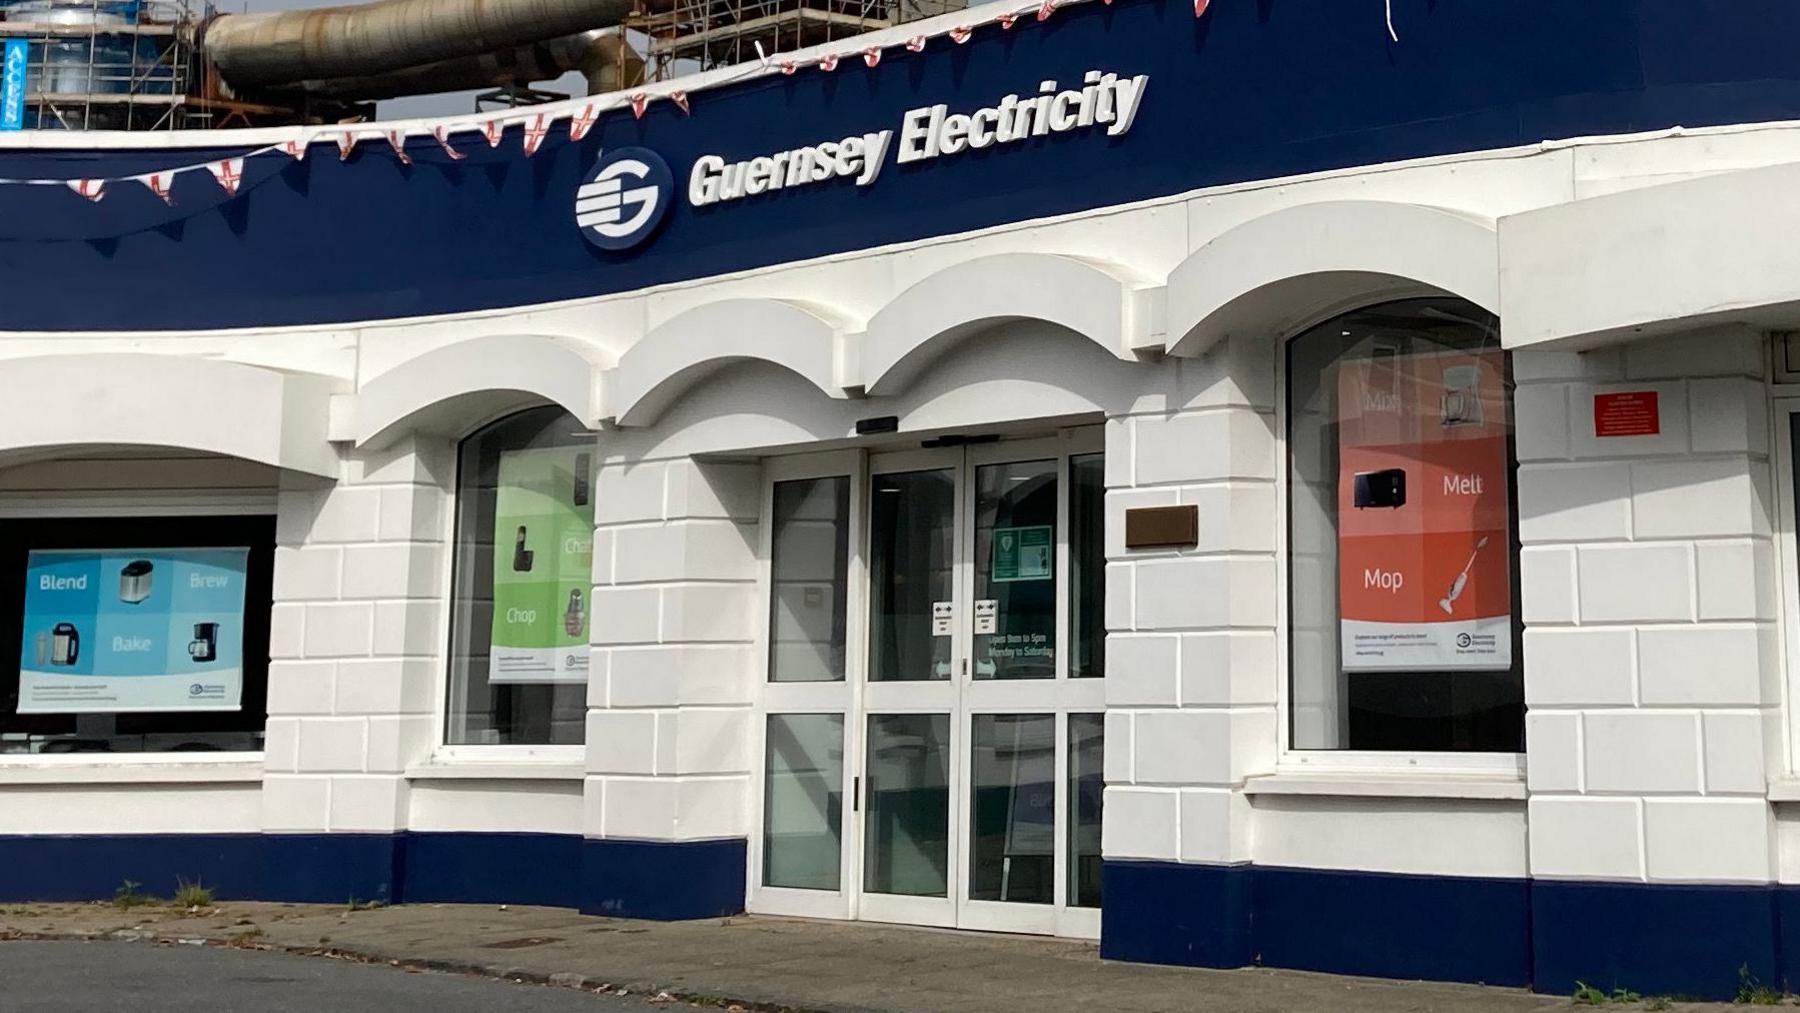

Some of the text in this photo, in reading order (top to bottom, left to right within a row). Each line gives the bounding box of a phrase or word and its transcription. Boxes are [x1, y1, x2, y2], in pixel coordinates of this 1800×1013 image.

[688, 70, 1149, 206] Guernsey Electricity
[1444, 475, 1483, 495] Melt
[40, 574, 87, 590] Blend
[190, 573, 228, 588] Brew
[1365, 569, 1403, 592] Mop
[507, 608, 536, 624] Chop
[113, 637, 151, 651] Bake
[1031, 633, 1047, 645] 5pm
[989, 647, 1015, 659] Monday
[1024, 646, 1053, 658] Saturday
